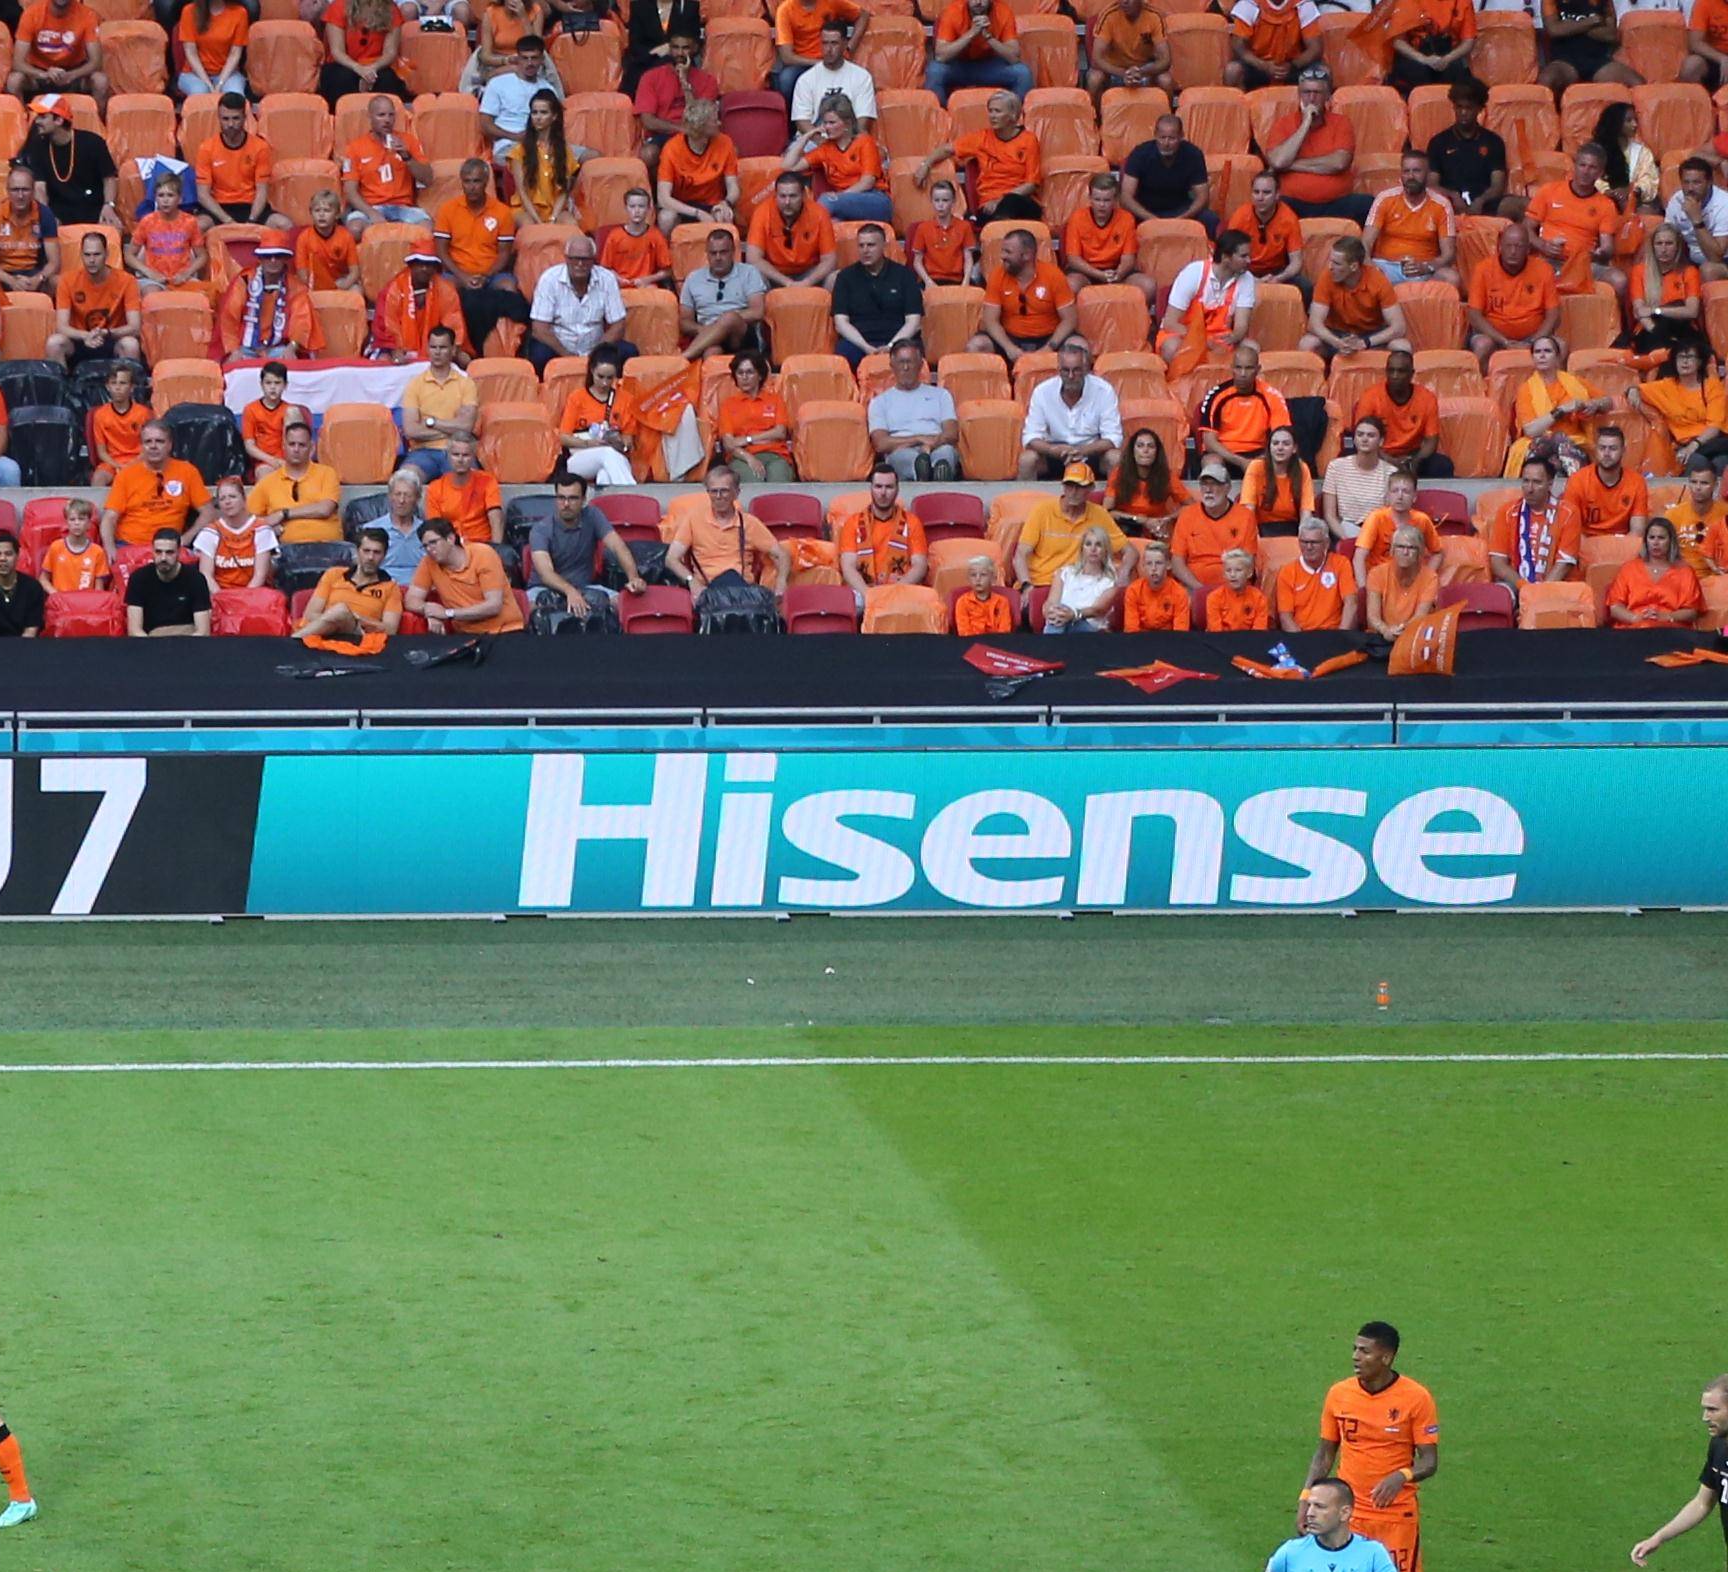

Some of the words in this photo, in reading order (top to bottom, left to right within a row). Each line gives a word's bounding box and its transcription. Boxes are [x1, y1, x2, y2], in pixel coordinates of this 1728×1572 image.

[378, 163, 393, 184] 10
[518, 752, 1525, 908] Hisense
[1334, 1414, 1358, 1443] 12
